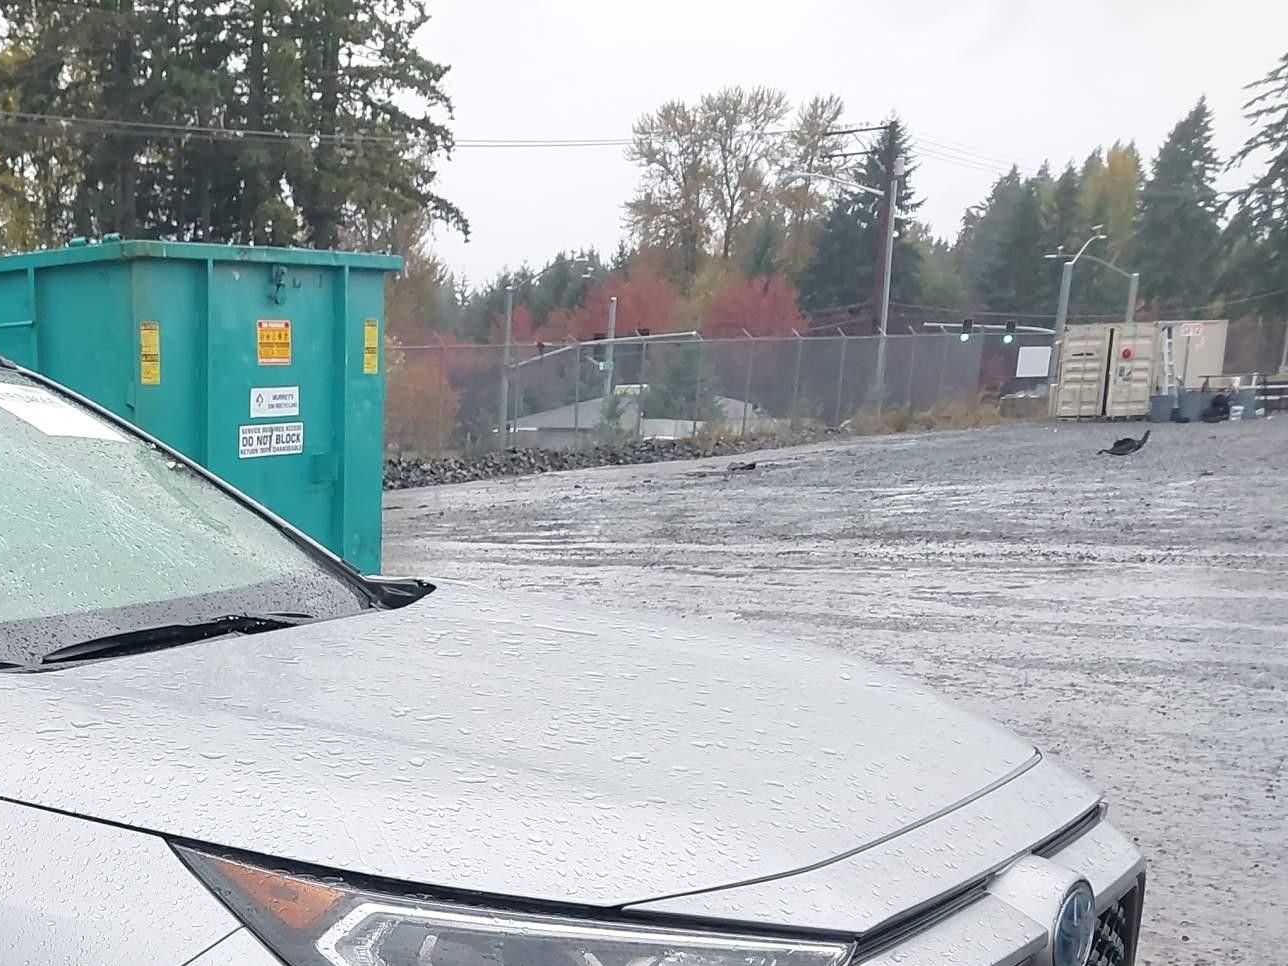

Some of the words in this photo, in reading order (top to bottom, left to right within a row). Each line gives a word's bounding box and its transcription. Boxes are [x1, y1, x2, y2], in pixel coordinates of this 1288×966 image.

[242, 436, 254, 447] DO
[256, 434, 272, 446] NOT
[275, 433, 301, 445] BLOCK
